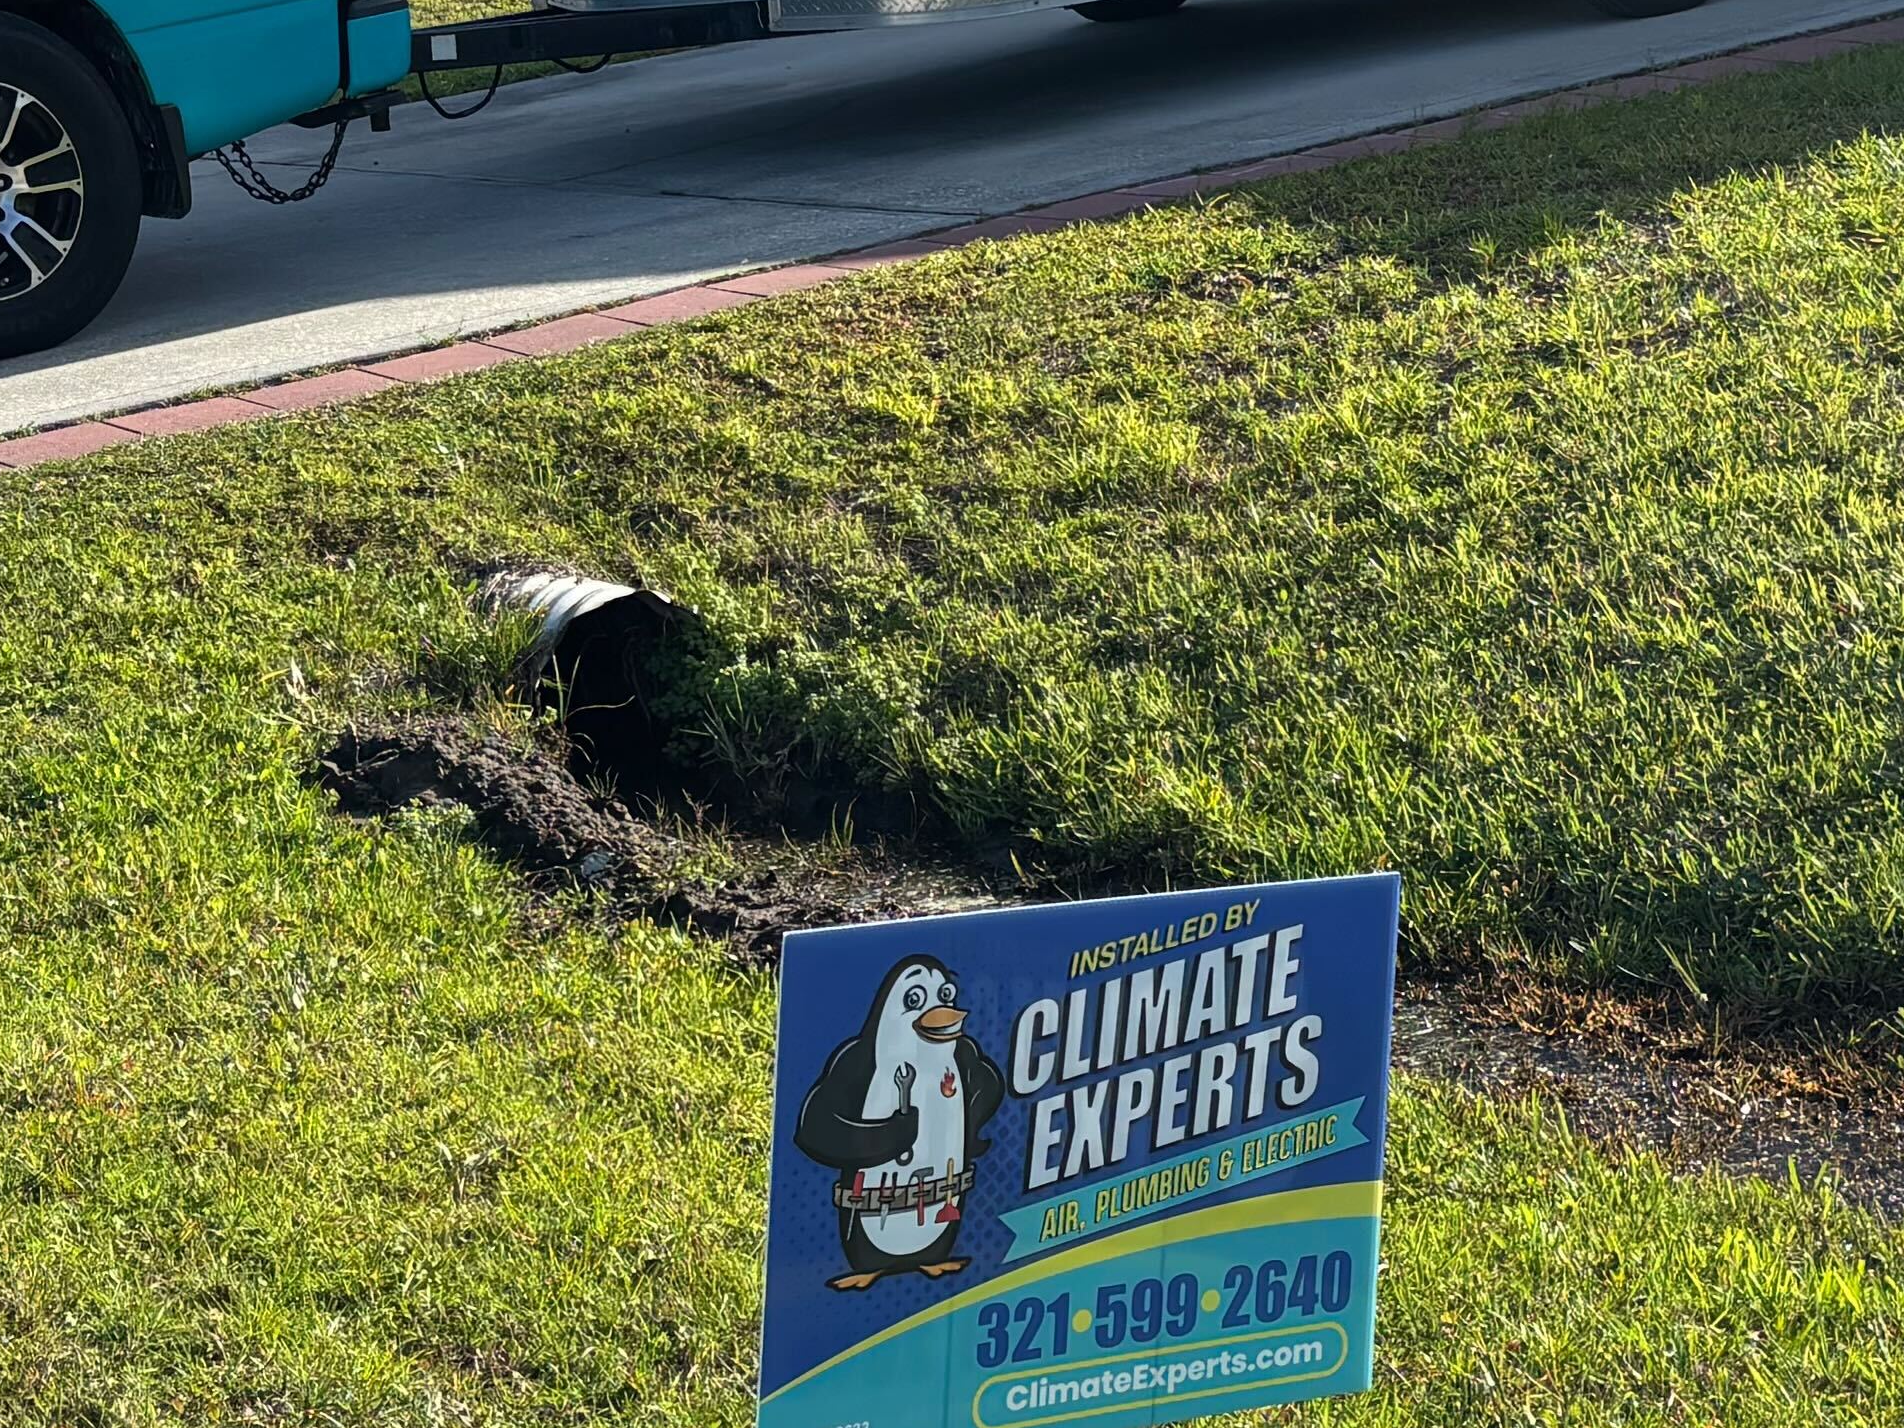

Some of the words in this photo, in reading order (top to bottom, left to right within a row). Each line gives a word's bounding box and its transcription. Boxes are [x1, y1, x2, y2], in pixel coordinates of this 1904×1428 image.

[1070, 911, 1218, 979] INSTALLED
[1224, 898, 1261, 933] BY
[1010, 923, 1305, 1096] CLIMATE
[1026, 1014, 1324, 1192] EXPERTS
[1039, 1199, 1087, 1243] AIR,
[1095, 1157, 1211, 1225] PLUMBING
[1218, 1149, 1234, 1182] &
[1241, 1114, 1339, 1174] ELECTRIC
[1004, 1339, 1324, 1412] ClimateExperts.com
